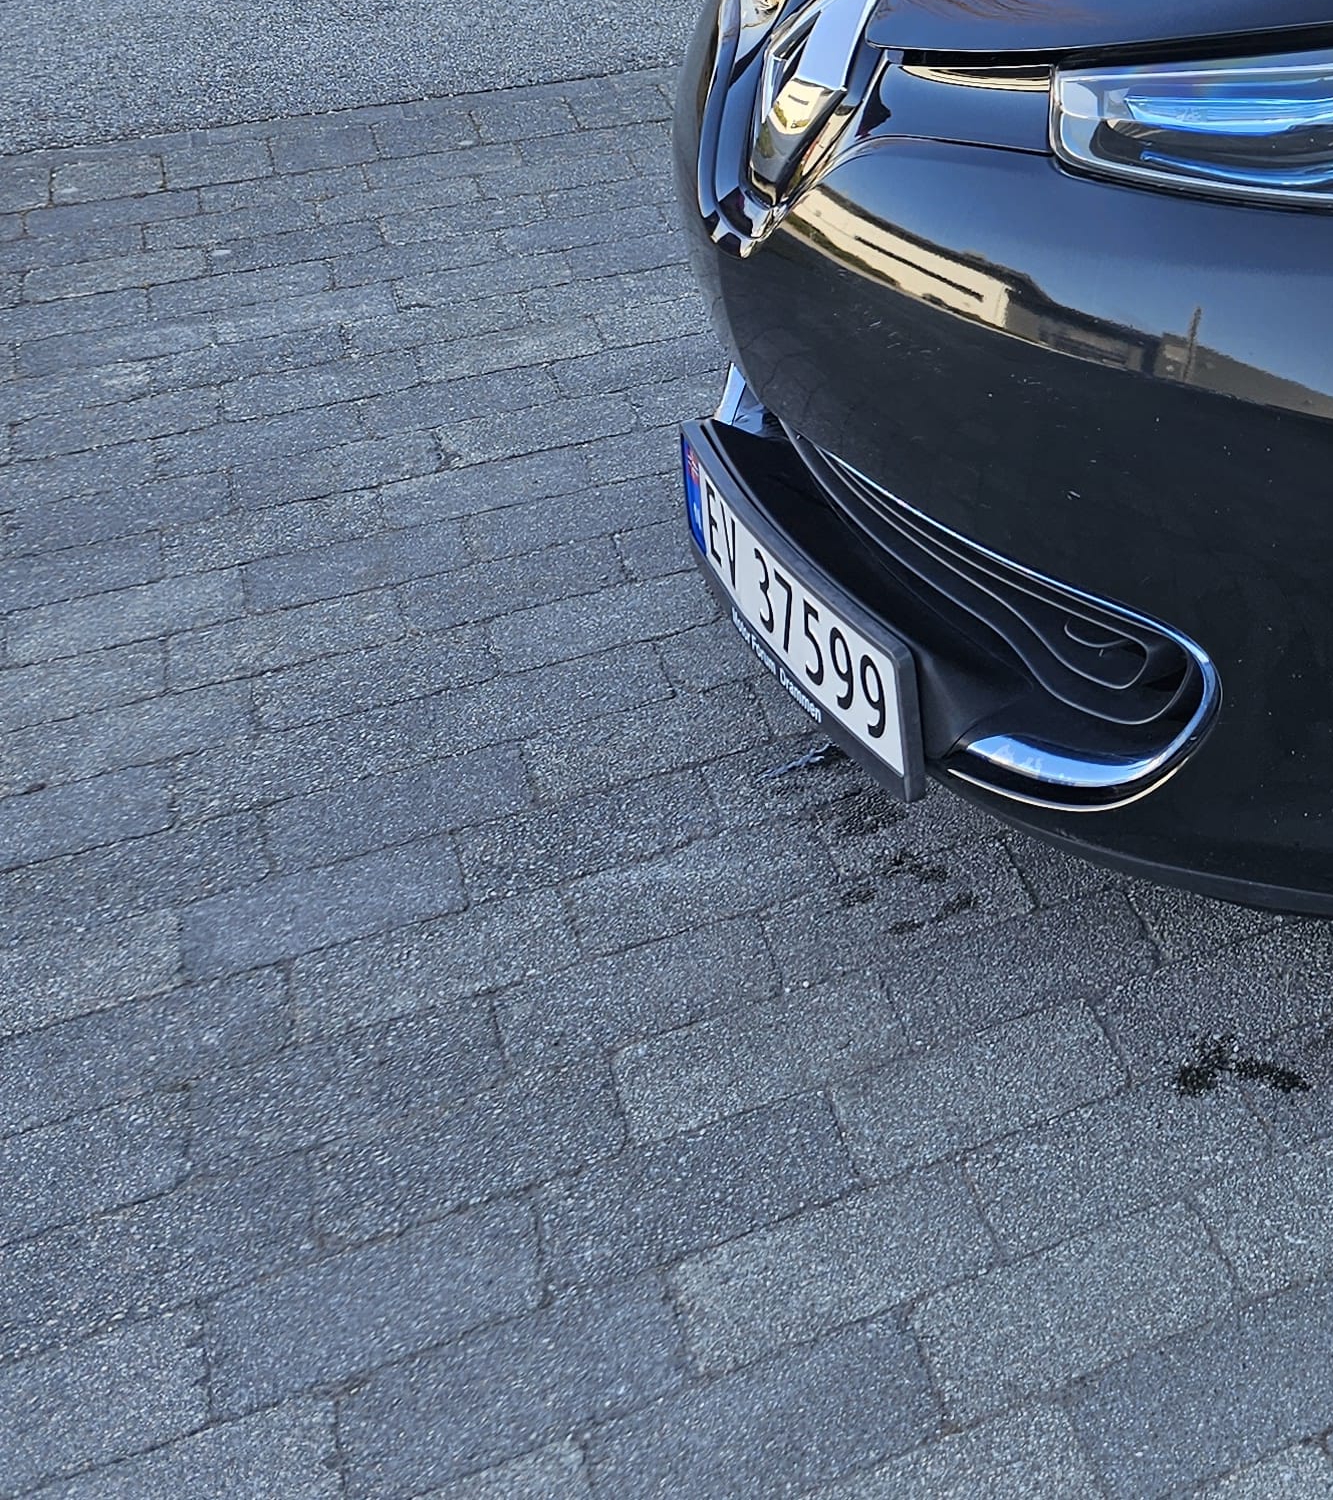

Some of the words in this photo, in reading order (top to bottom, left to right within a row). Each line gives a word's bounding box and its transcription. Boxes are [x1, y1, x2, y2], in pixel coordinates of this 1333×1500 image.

[705, 478, 736, 590] EV
[754, 548, 887, 740] 37599
[779, 667, 822, 723] Drammen
